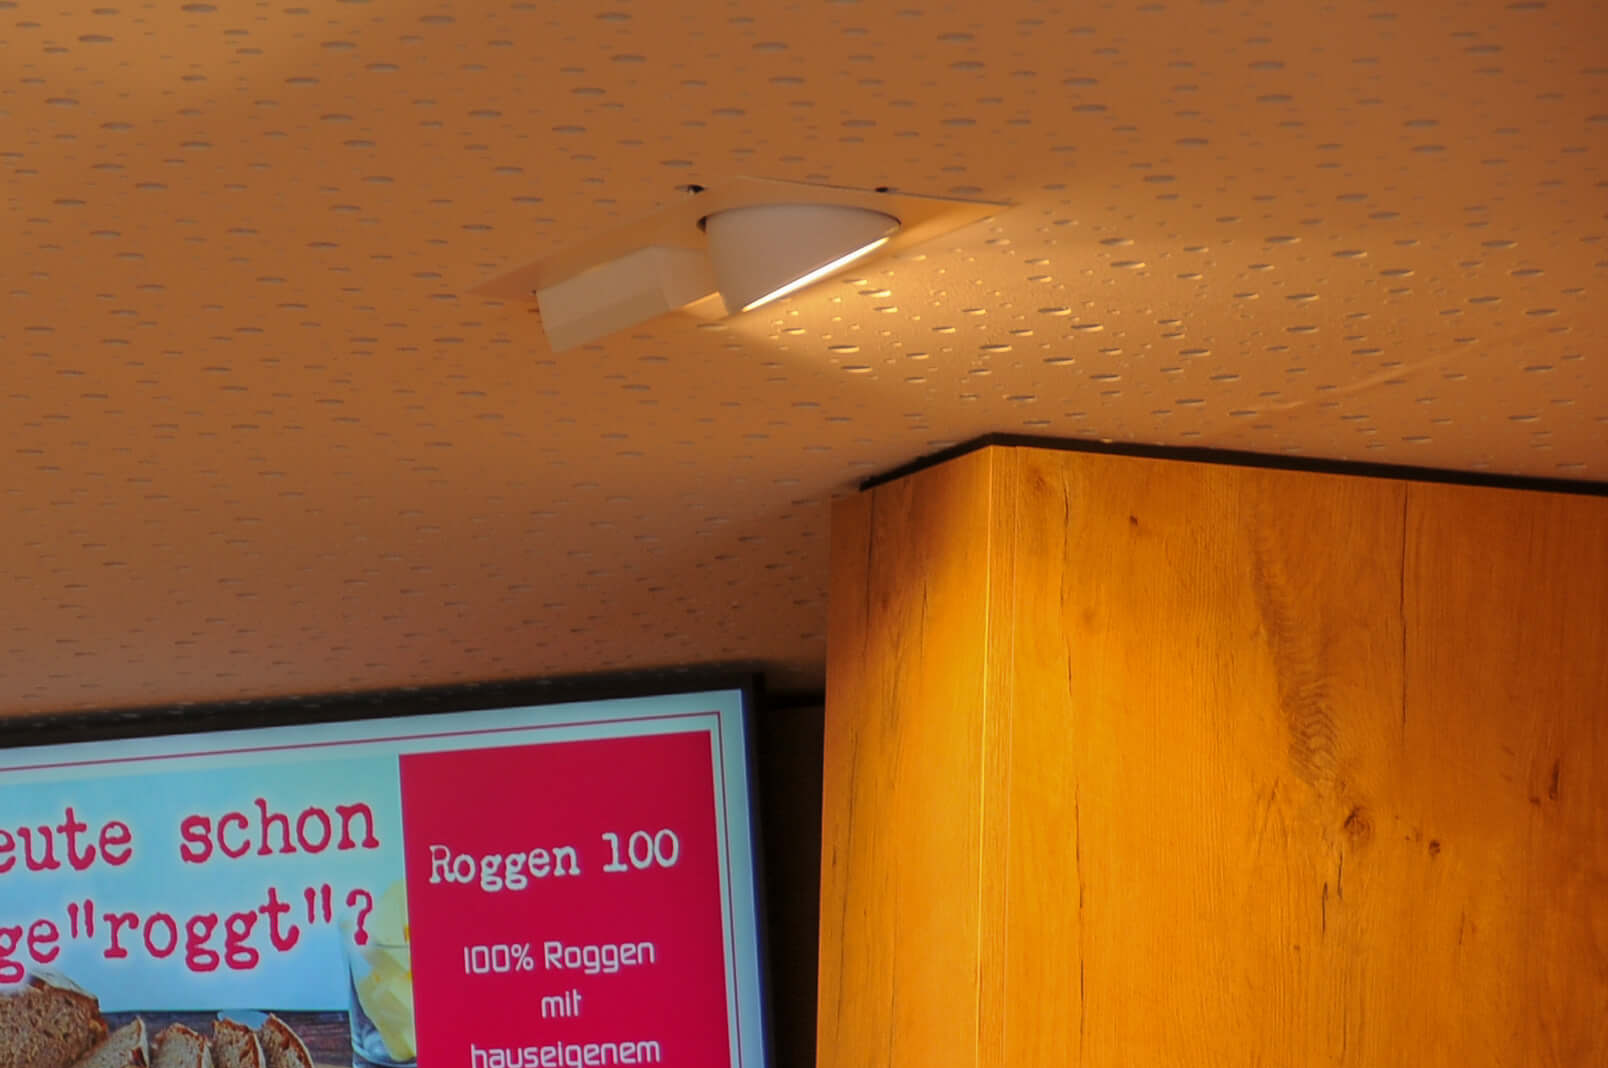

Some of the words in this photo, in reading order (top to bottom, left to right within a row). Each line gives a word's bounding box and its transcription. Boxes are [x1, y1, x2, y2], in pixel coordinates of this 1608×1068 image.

[180, 798, 380, 864] schon
[429, 845, 580, 892] Roggen
[602, 829, 680, 873] 100
[463, 943, 534, 974] 100%
[544, 941, 655, 974] Roggen
[541, 988, 582, 1018] mit
